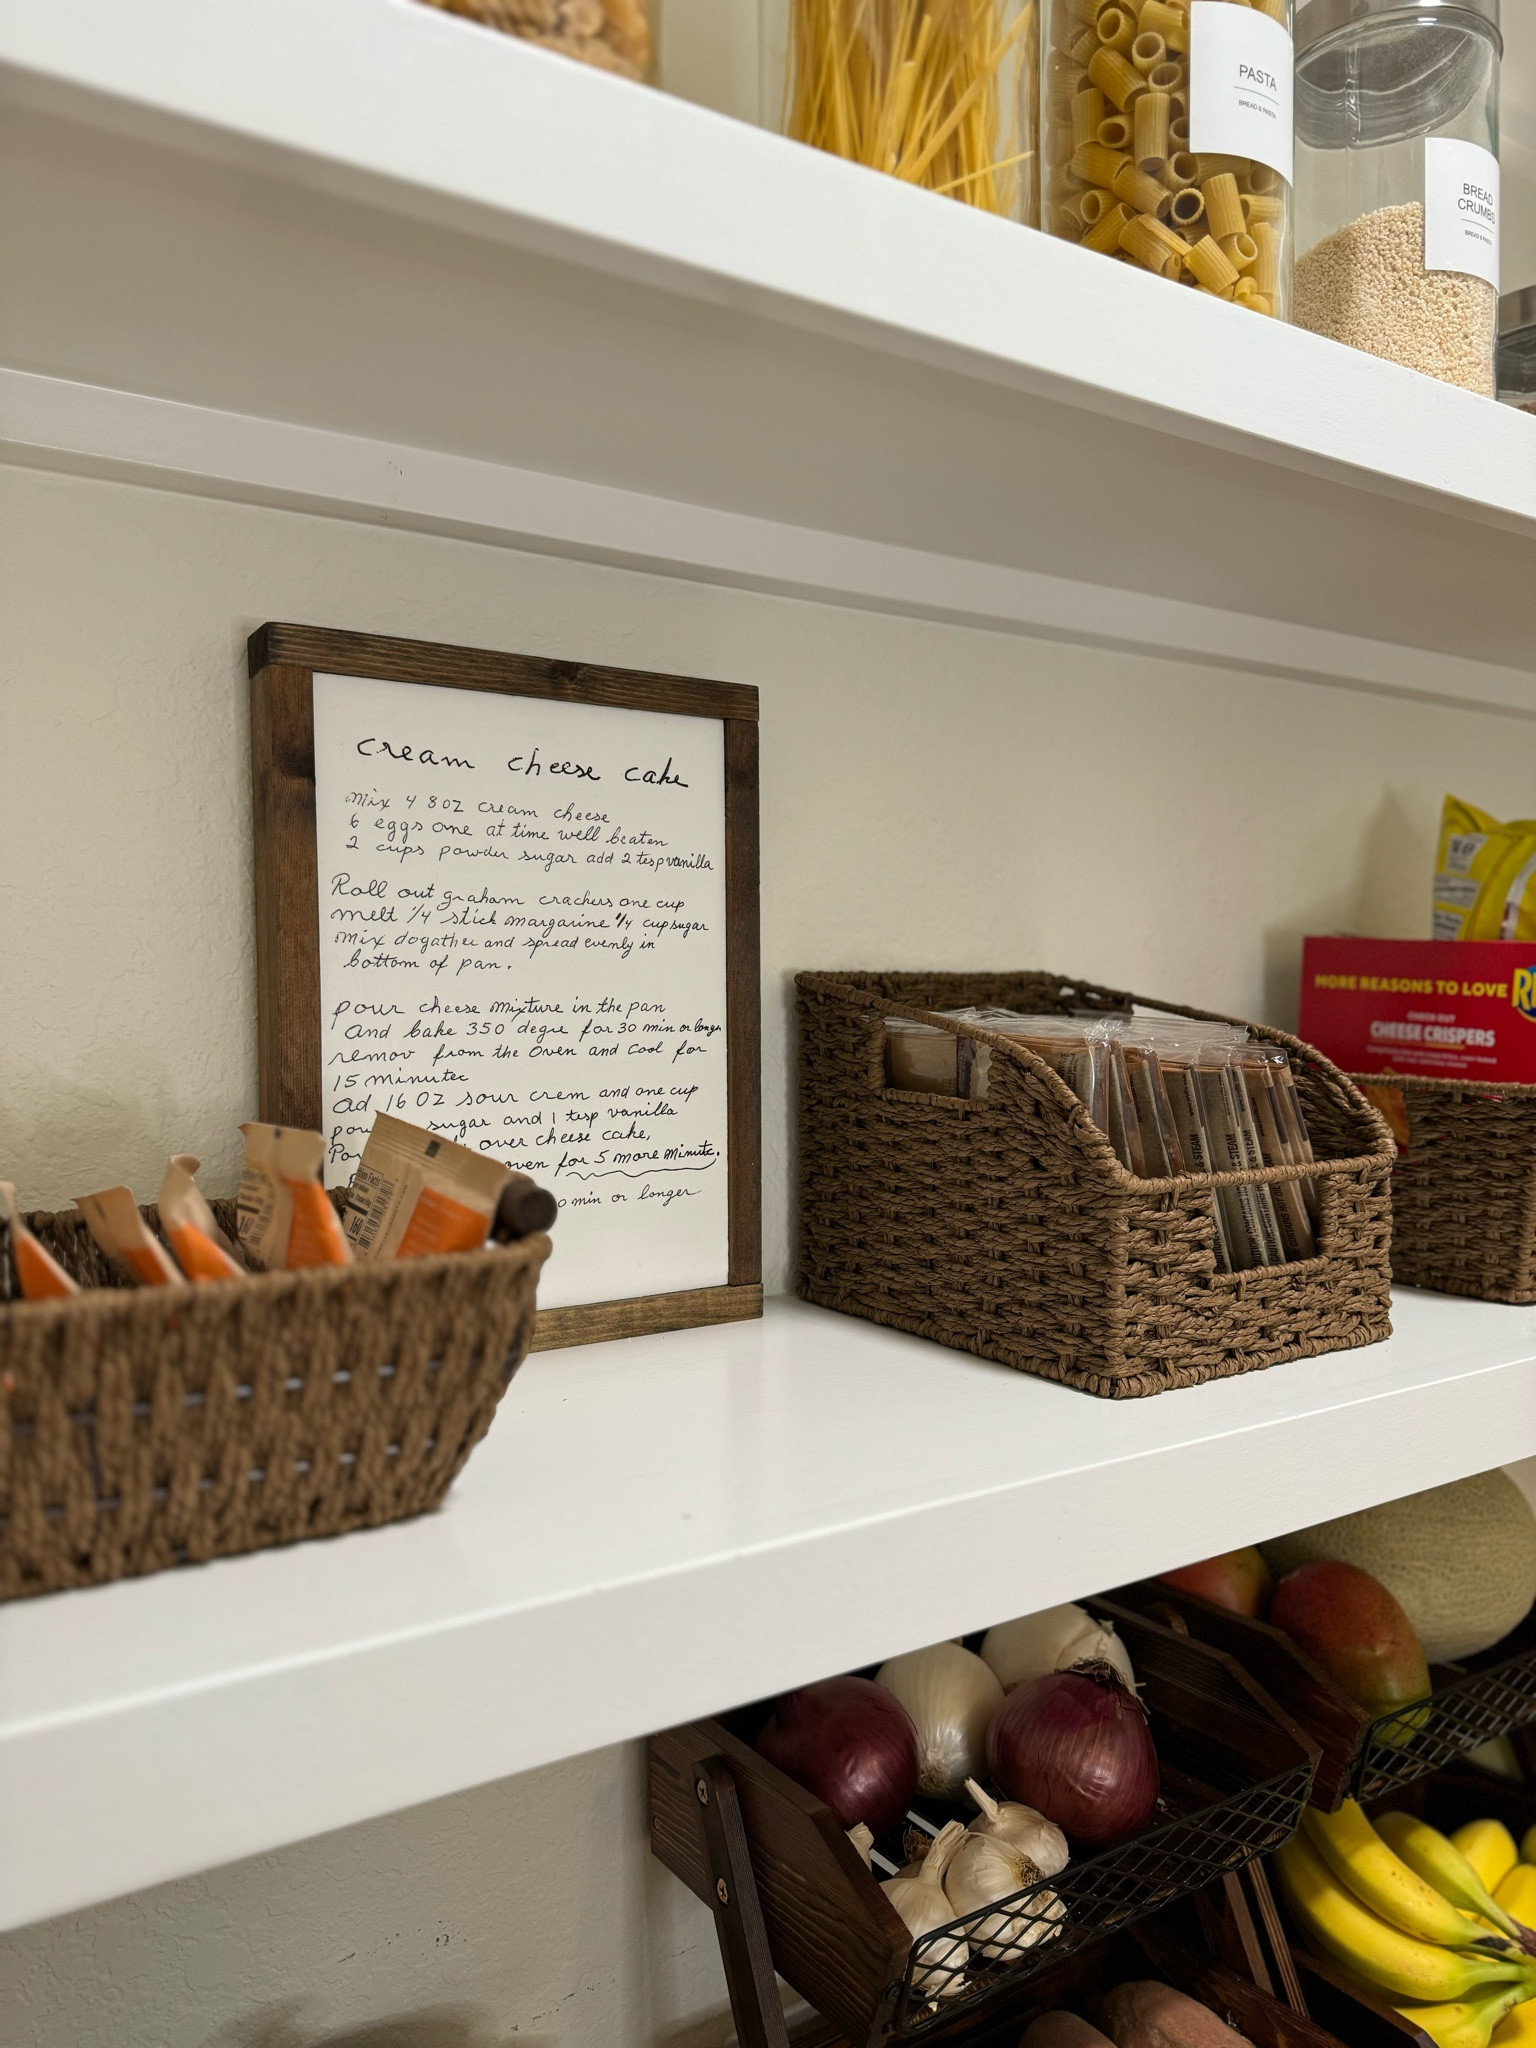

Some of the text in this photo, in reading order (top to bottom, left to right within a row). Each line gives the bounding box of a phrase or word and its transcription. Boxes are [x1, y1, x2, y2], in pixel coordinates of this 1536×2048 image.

[1239, 64, 1277, 92] PASTA
[1238, 99, 1258, 110] BREAD
[1262, 107, 1277, 119] PASTA
[1463, 182, 1493, 206] BREAD
[1457, 197, 1496, 225] CRUMBS
[357, 738, 689, 788] cream cheese cake
[406, 795, 417, 810] 4
[477, 801, 538, 818] cream
[553, 802, 610, 823] cheese
[349, 812, 669, 847] 6 eggs one at time well beaten
[345, 835, 359, 850] 2
[376, 844, 425, 864] cups
[438, 845, 509, 862] powder
[518, 850, 577, 872] sugar
[586, 851, 614, 865] add
[621, 852, 632, 865] 2
[331, 872, 685, 913] Roll out graham crackers one cup
[406, 903, 432, 924] 1/4
[440, 906, 497, 925] stick
[484, 936, 515, 949] and
[522, 936, 579, 959] spread
[639, 933, 656, 950] in
[343, 948, 512, 976] bottom of pan.
[1315, 974, 1357, 990] MORE
[1360, 976, 1433, 995] REASONS
[1436, 979, 1459, 996] TO
[1461, 981, 1508, 998] LOVE
[419, 995, 480, 1014] cheese
[572, 996, 592, 1013] in
[596, 997, 623, 1014] the
[625, 1000, 666, 1019] pan
[403, 1019, 457, 1038] bake
[466, 1021, 505, 1036] 350
[579, 1018, 613, 1043] for
[617, 1023, 637, 1034] 30
[642, 1018, 676, 1033] min
[679, 1024, 692, 1032] or
[1370, 1020, 1496, 1048] CHEESE CRISPERS
[432, 1043, 484, 1067] from
[492, 1044, 520, 1059] the
[588, 1043, 619, 1056] and
[672, 1040, 707, 1064] for
[333, 1073, 361, 1091] 15
[386, 1092, 406, 1112] 16
[455, 1091, 519, 1107] sour
[599, 1085, 631, 1099] and
[635, 1085, 665, 1096] one
[669, 1084, 699, 1102] cup
[425, 1117, 491, 1138] sugar
[503, 1111, 542, 1125] and
[607, 1101, 678, 1118] vanilla
[479, 1137, 528, 1151] over
[535, 1127, 591, 1146] cheese
[1189, 1133, 1203, 1160] STEAM
[1225, 1133, 1239, 1159] STEAM
[1242, 1128, 1255, 1154] STEAM
[554, 1151, 590, 1178] for
[593, 1149, 610, 1164] 5
[612, 1149, 659, 1164] more
[571, 1191, 601, 1207] min
[611, 1193, 628, 1203] or
[637, 1183, 702, 1207] longer
[1271, 1184, 1283, 1196] OIL
[1239, 1196, 1256, 1233] CONTAINS
[1275, 1197, 1288, 1211] HOT
